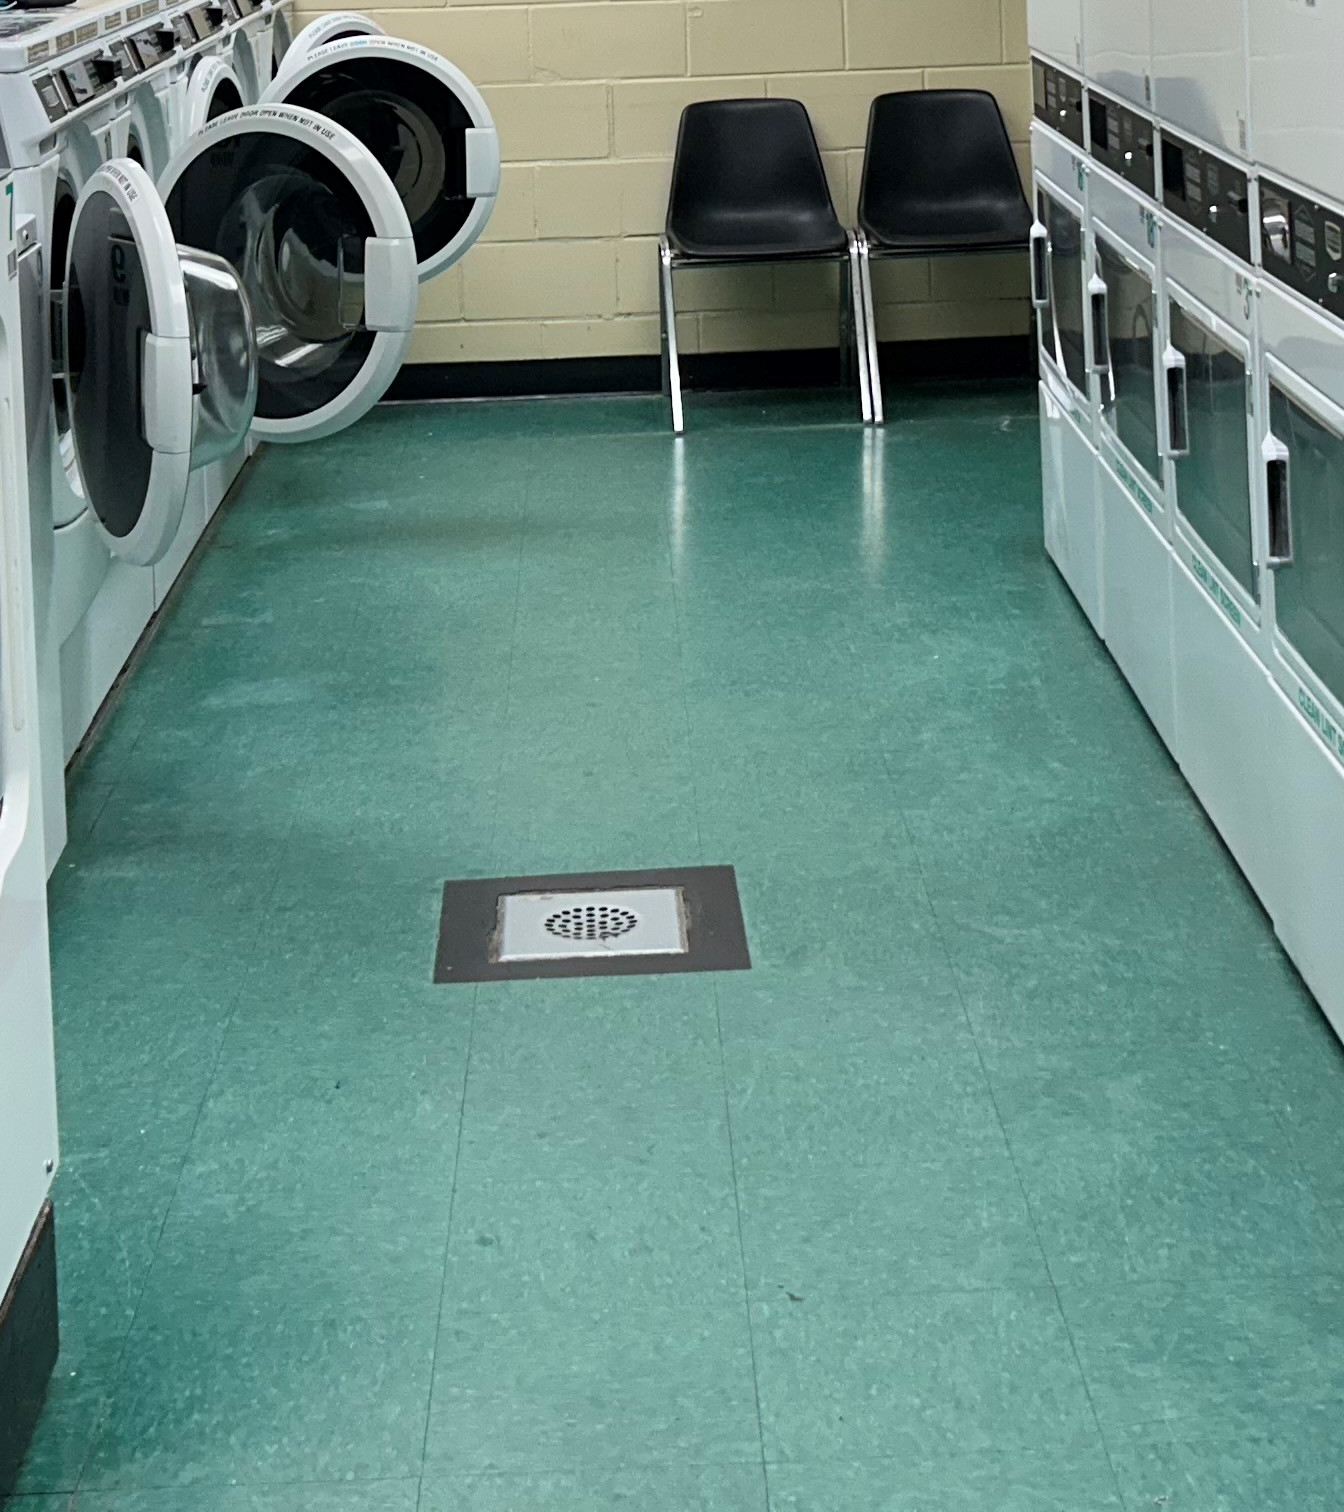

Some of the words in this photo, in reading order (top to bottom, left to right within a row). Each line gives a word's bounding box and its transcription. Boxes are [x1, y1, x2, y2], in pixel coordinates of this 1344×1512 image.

[240, 109, 258, 119] DOOR
[259, 109, 277, 118] OPEN
[279, 112, 298, 122] WHEN
[300, 117, 314, 128] NOT
[313, 123, 321, 132] IN
[321, 127, 336, 141] USE
[1298, 687, 1321, 728] CLEAN
[1319, 711, 1336, 745] LINT
